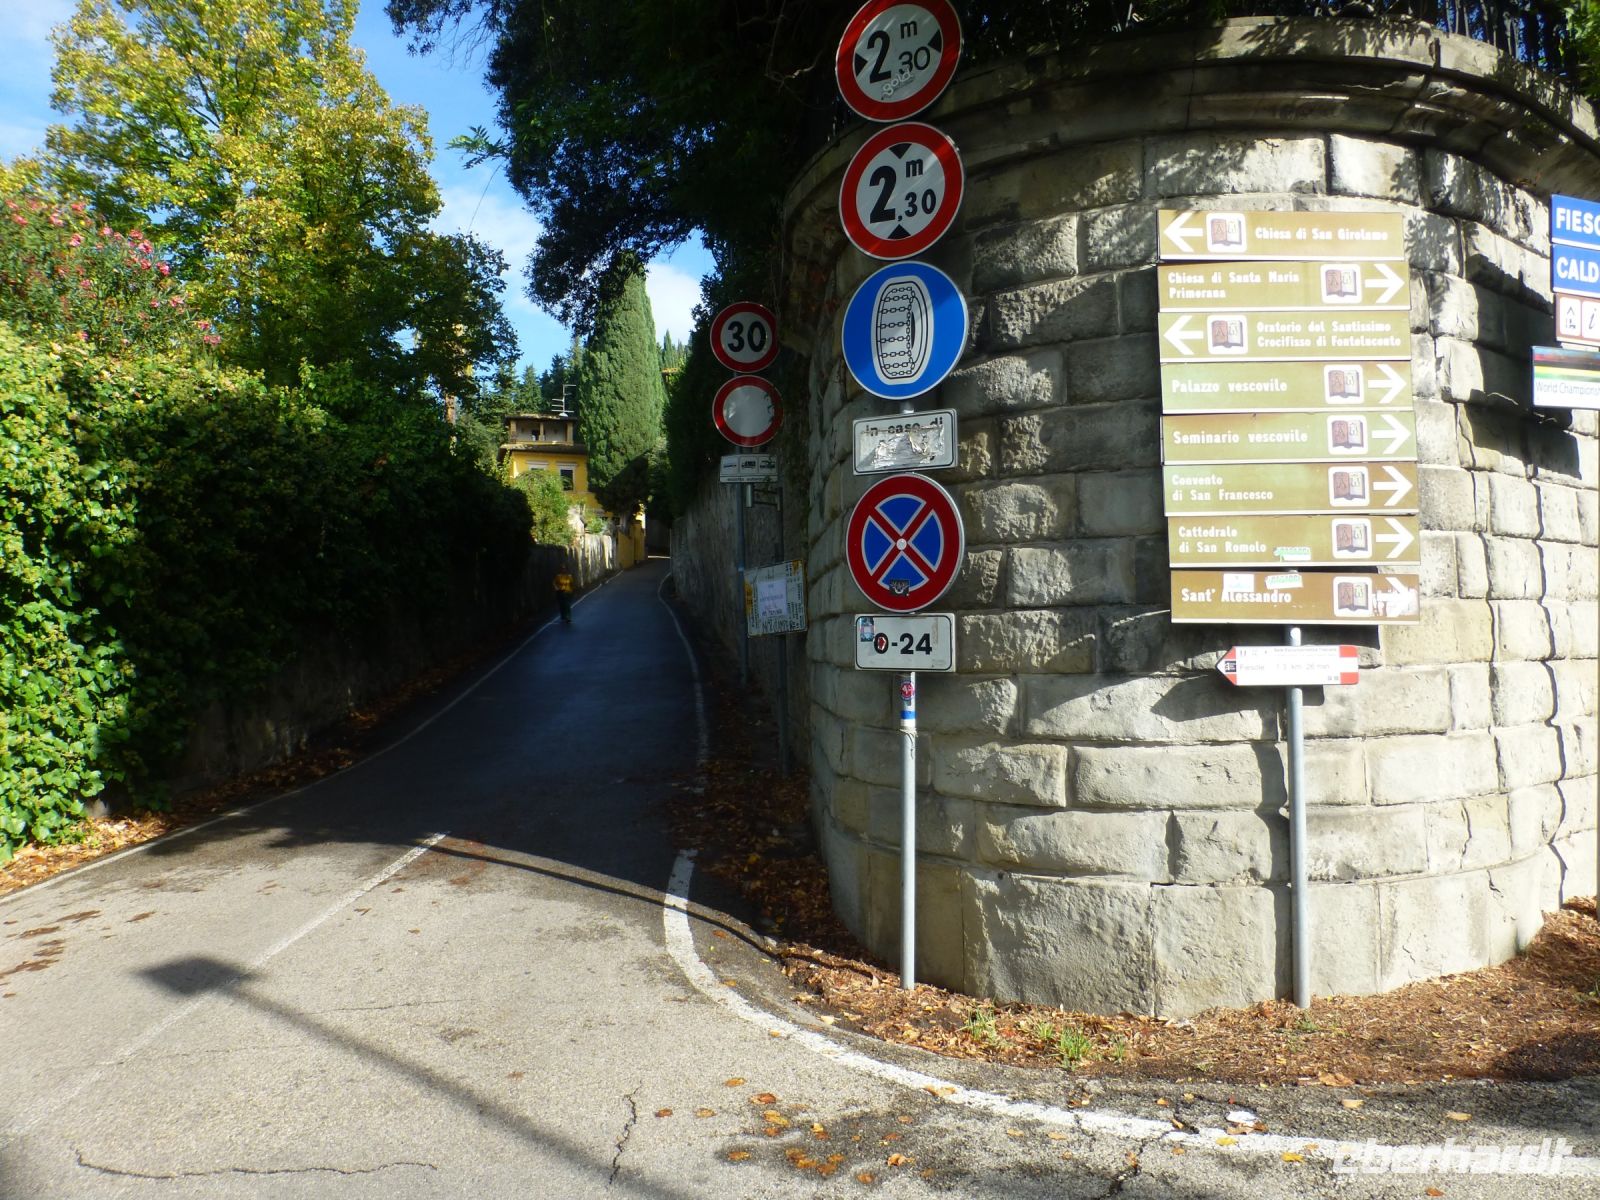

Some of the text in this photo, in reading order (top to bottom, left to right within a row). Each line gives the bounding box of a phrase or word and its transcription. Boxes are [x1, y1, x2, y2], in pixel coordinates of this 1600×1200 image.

[900, 20, 918, 39] m
[905, 158, 924, 178] m
[1255, 228, 1388, 241] Chiesa di San Girolamo
[1556, 256, 1600, 284] CALD
[1168, 271, 1299, 284] Chiesa di Santa Maria
[1256, 320, 1391, 333] Oratorio del Santissimo
[727, 321, 767, 353] 30
[1257, 335, 1311, 347] Crocifisso
[1316, 335, 1327, 347] di
[1172, 378, 1287, 393] Palazzo vescovile
[1536, 381, 1558, 393] World
[1173, 430, 1308, 444] Seminario vescovile
[1172, 474, 1223, 486] Convento
[1172, 488, 1273, 501] di San Francesco
[1179, 526, 1238, 538] Cattedrale
[1179, 541, 1189, 553] di
[1197, 542, 1217, 553] San
[1225, 541, 1267, 553] Romolo
[1221, 589, 1292, 603] Alessandro
